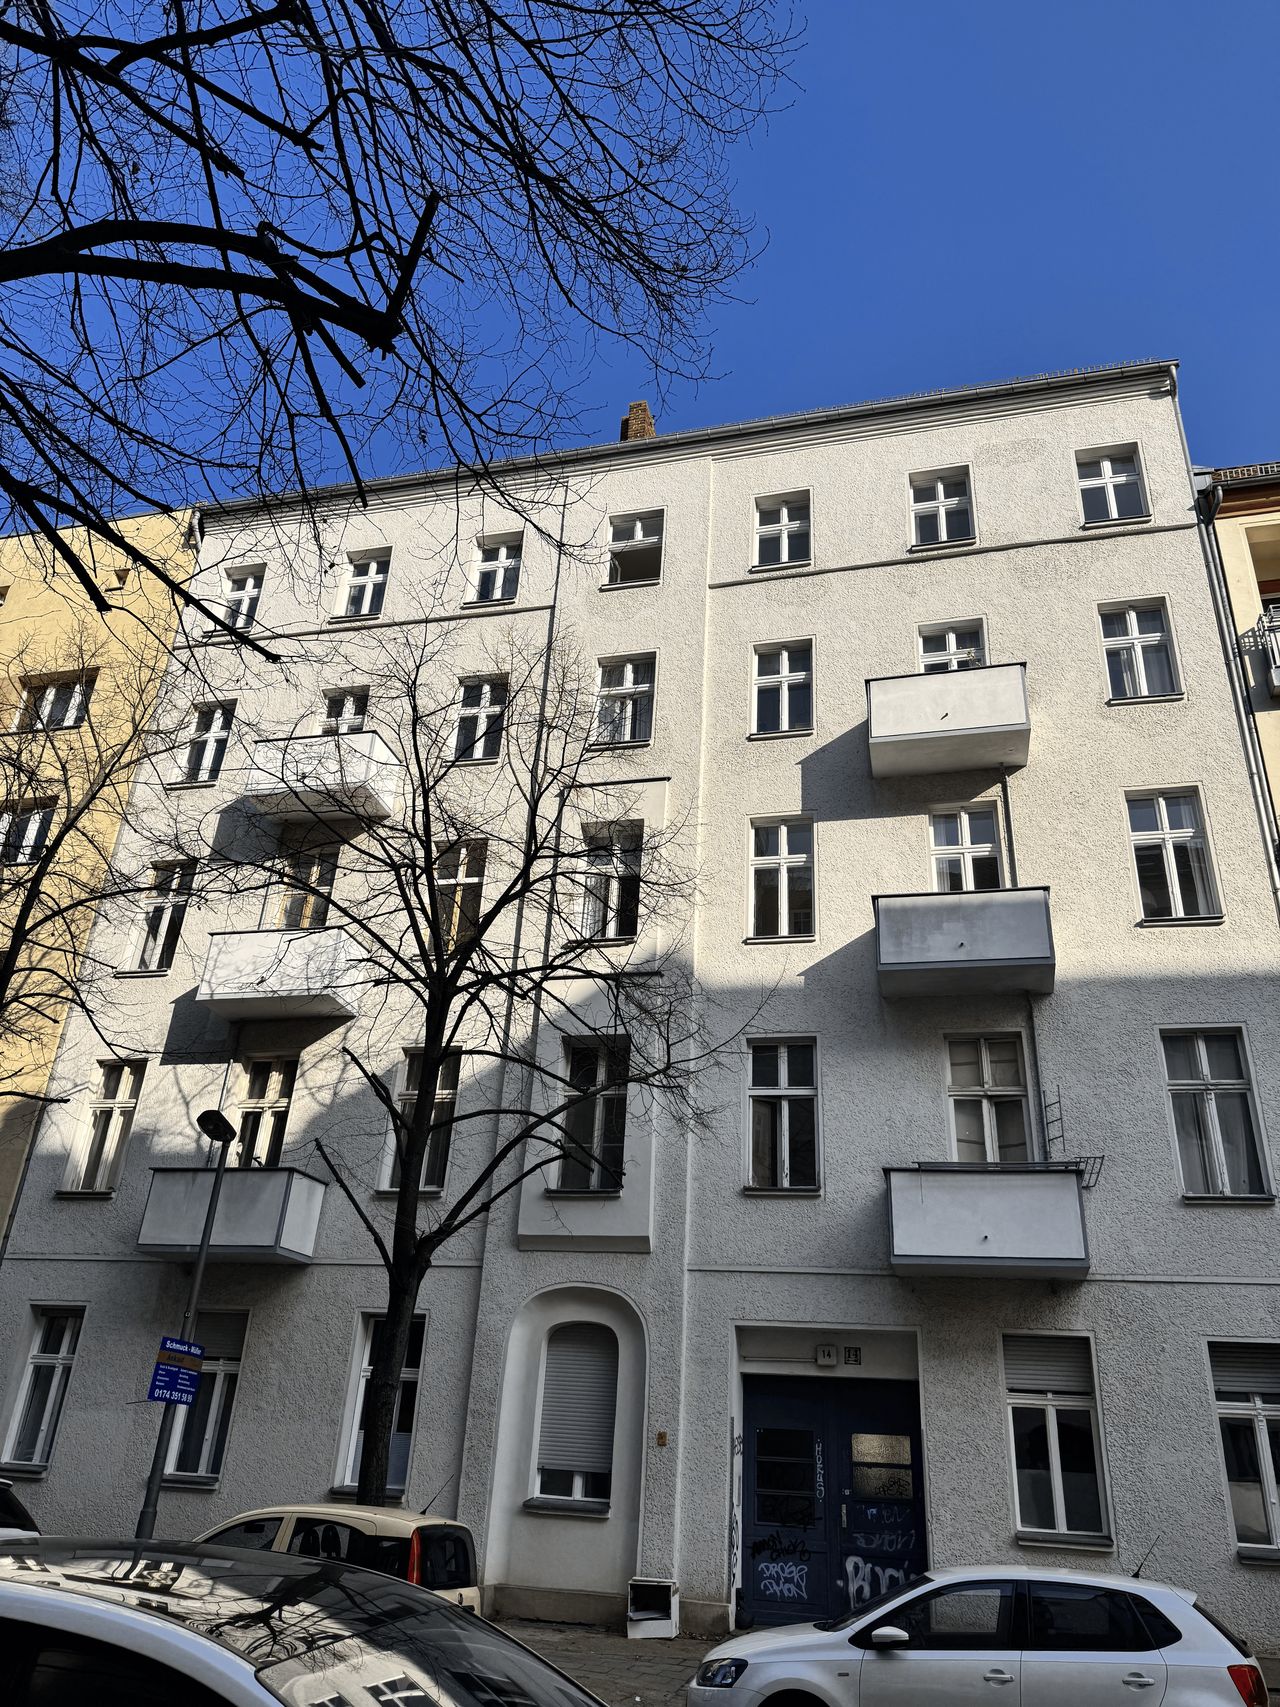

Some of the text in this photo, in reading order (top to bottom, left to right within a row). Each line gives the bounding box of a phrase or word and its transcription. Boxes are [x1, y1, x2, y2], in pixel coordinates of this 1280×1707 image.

[165, 1340, 189, 1352] Schmuck
[822, 1349, 831, 1359] 14
[154, 1388, 170, 1399] 0174
[171, 1390, 181, 1400] 351
